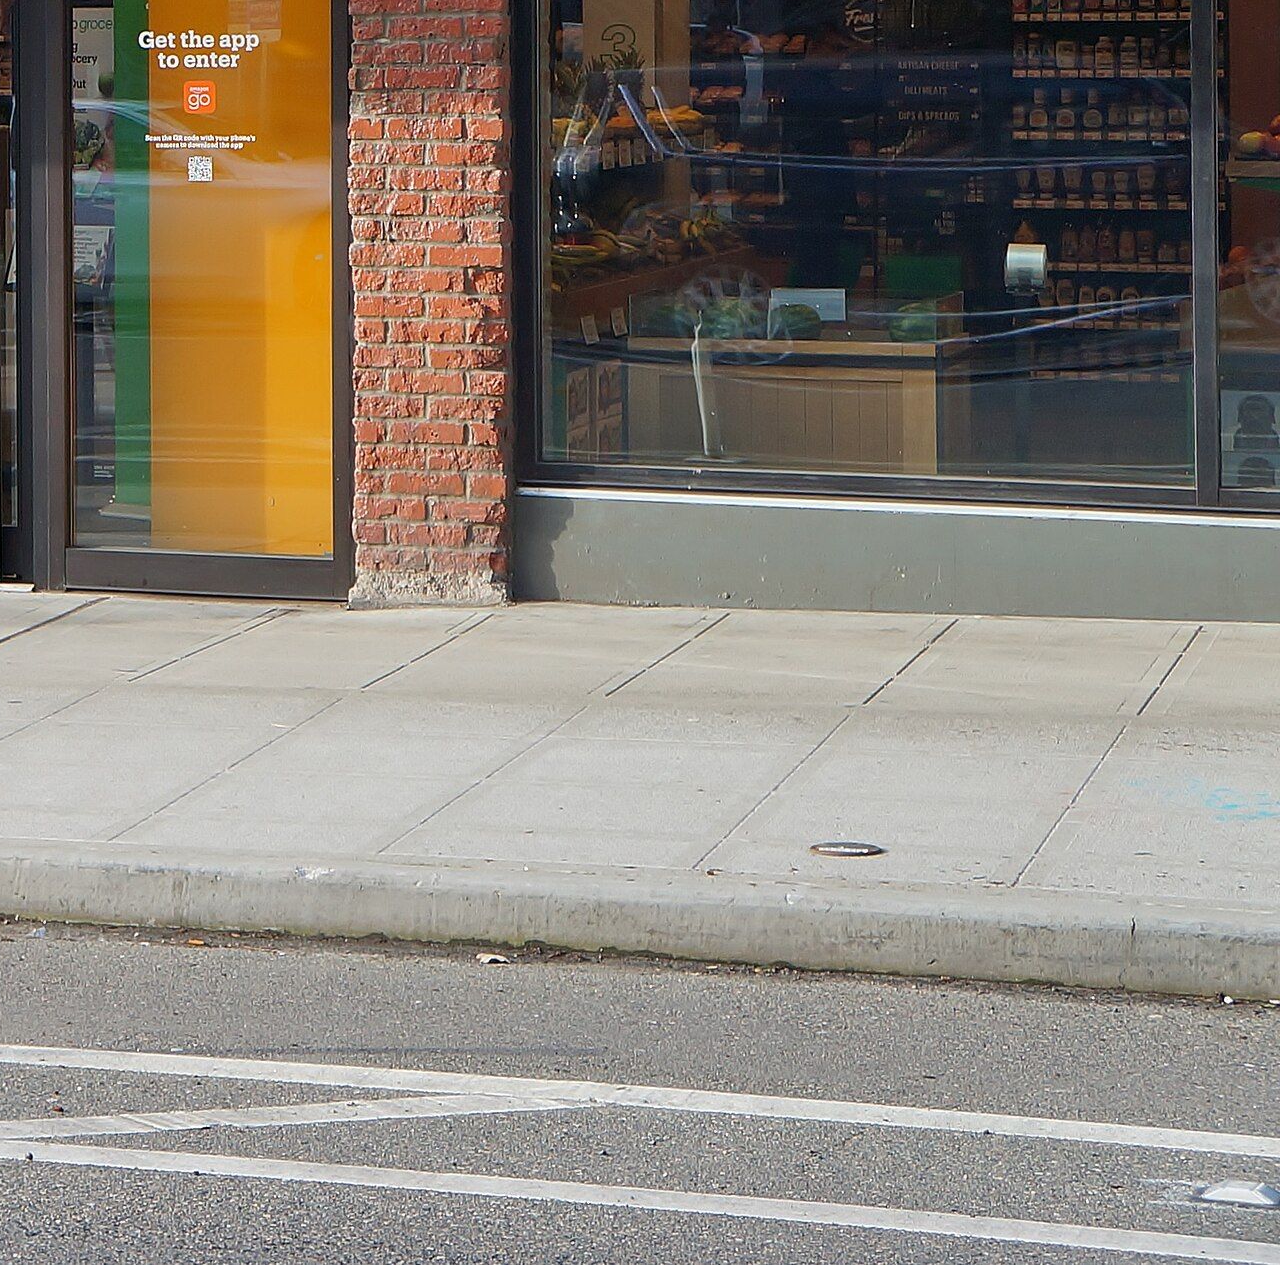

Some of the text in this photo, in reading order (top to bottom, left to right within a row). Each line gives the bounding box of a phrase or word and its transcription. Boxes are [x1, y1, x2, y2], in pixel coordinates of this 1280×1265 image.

[138, 29, 259, 52] Get the app
[157, 52, 240, 69] to enter
[188, 93, 211, 110] go
